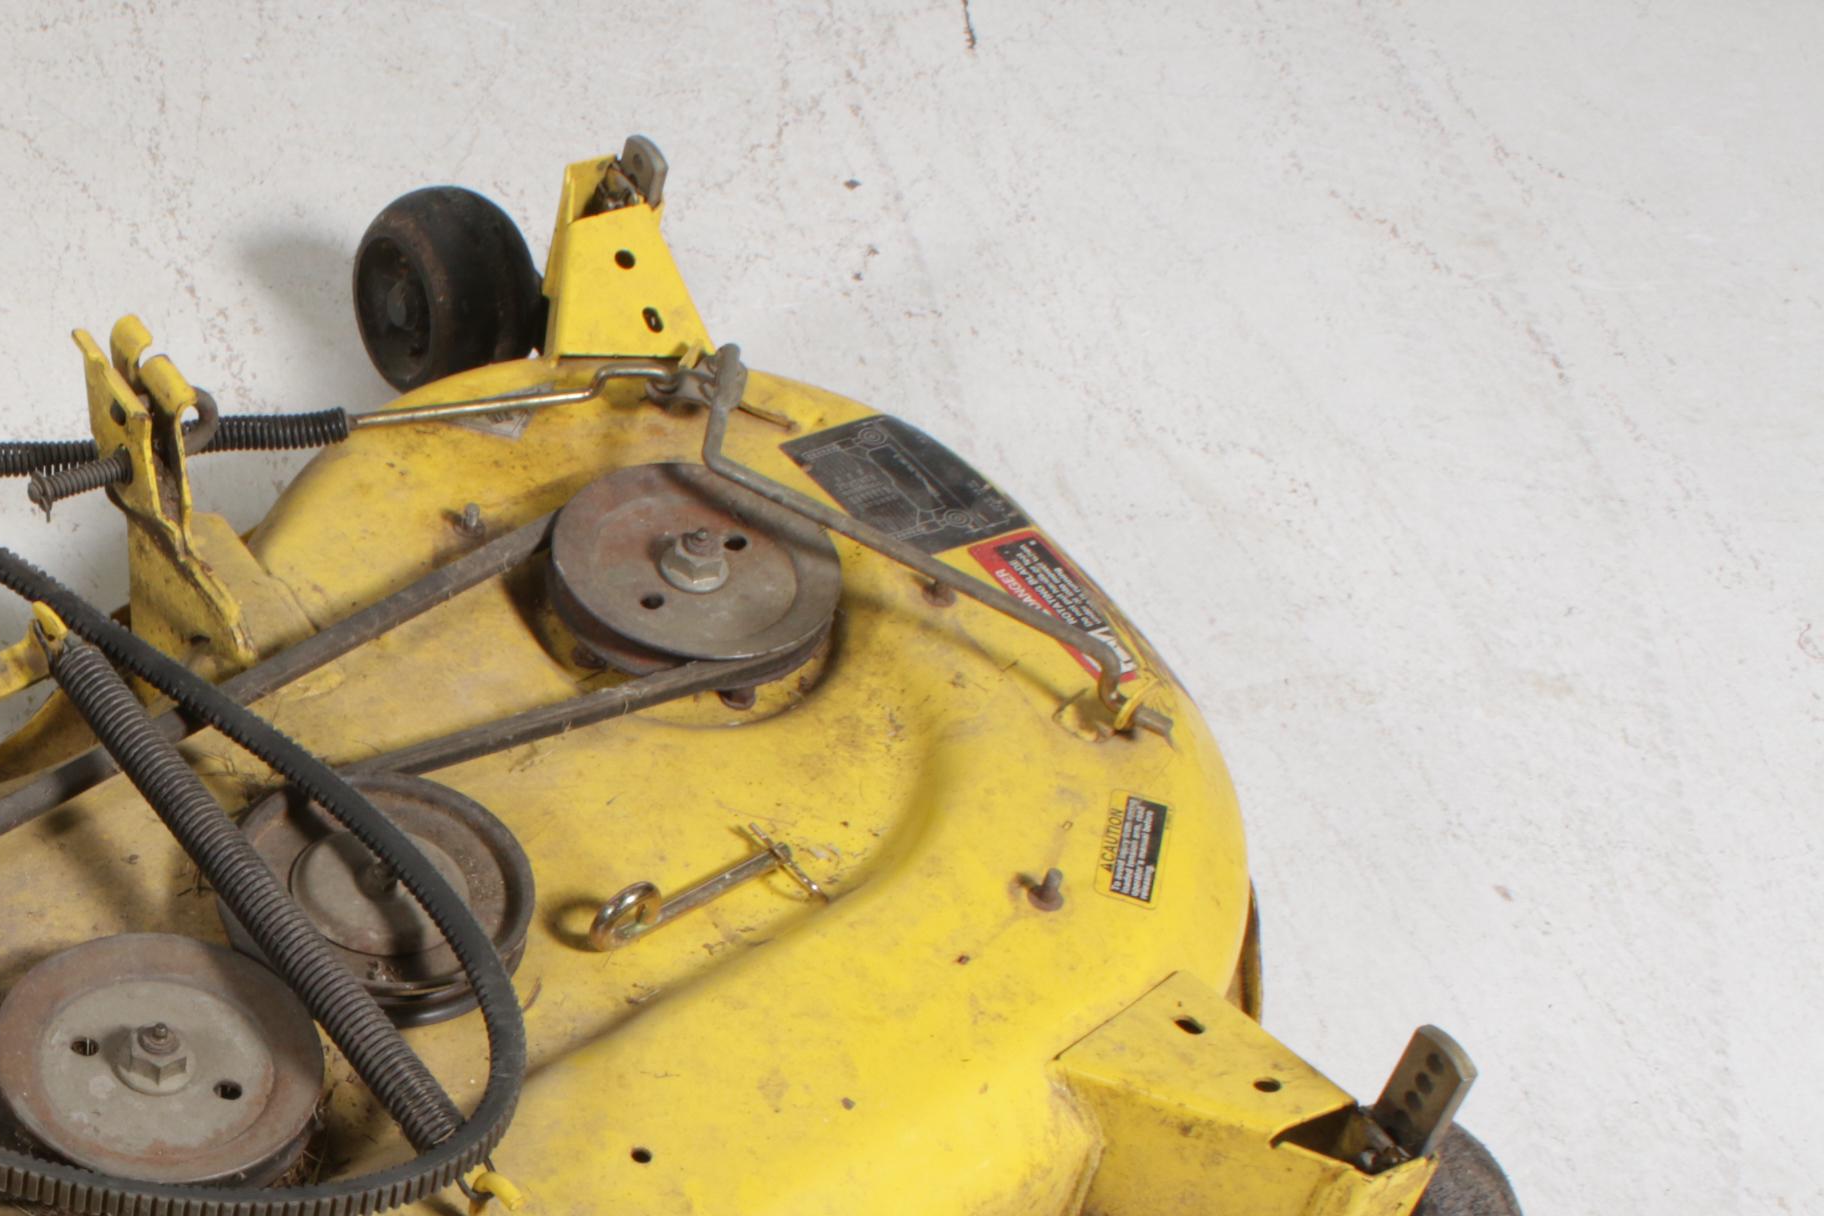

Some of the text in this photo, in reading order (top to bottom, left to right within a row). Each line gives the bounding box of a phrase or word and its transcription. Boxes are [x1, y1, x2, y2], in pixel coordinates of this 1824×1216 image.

[1008, 559, 1039, 586] BLADE
[1035, 584, 1077, 625] ROTATING
[1101, 808, 1123, 862] CAUTION
